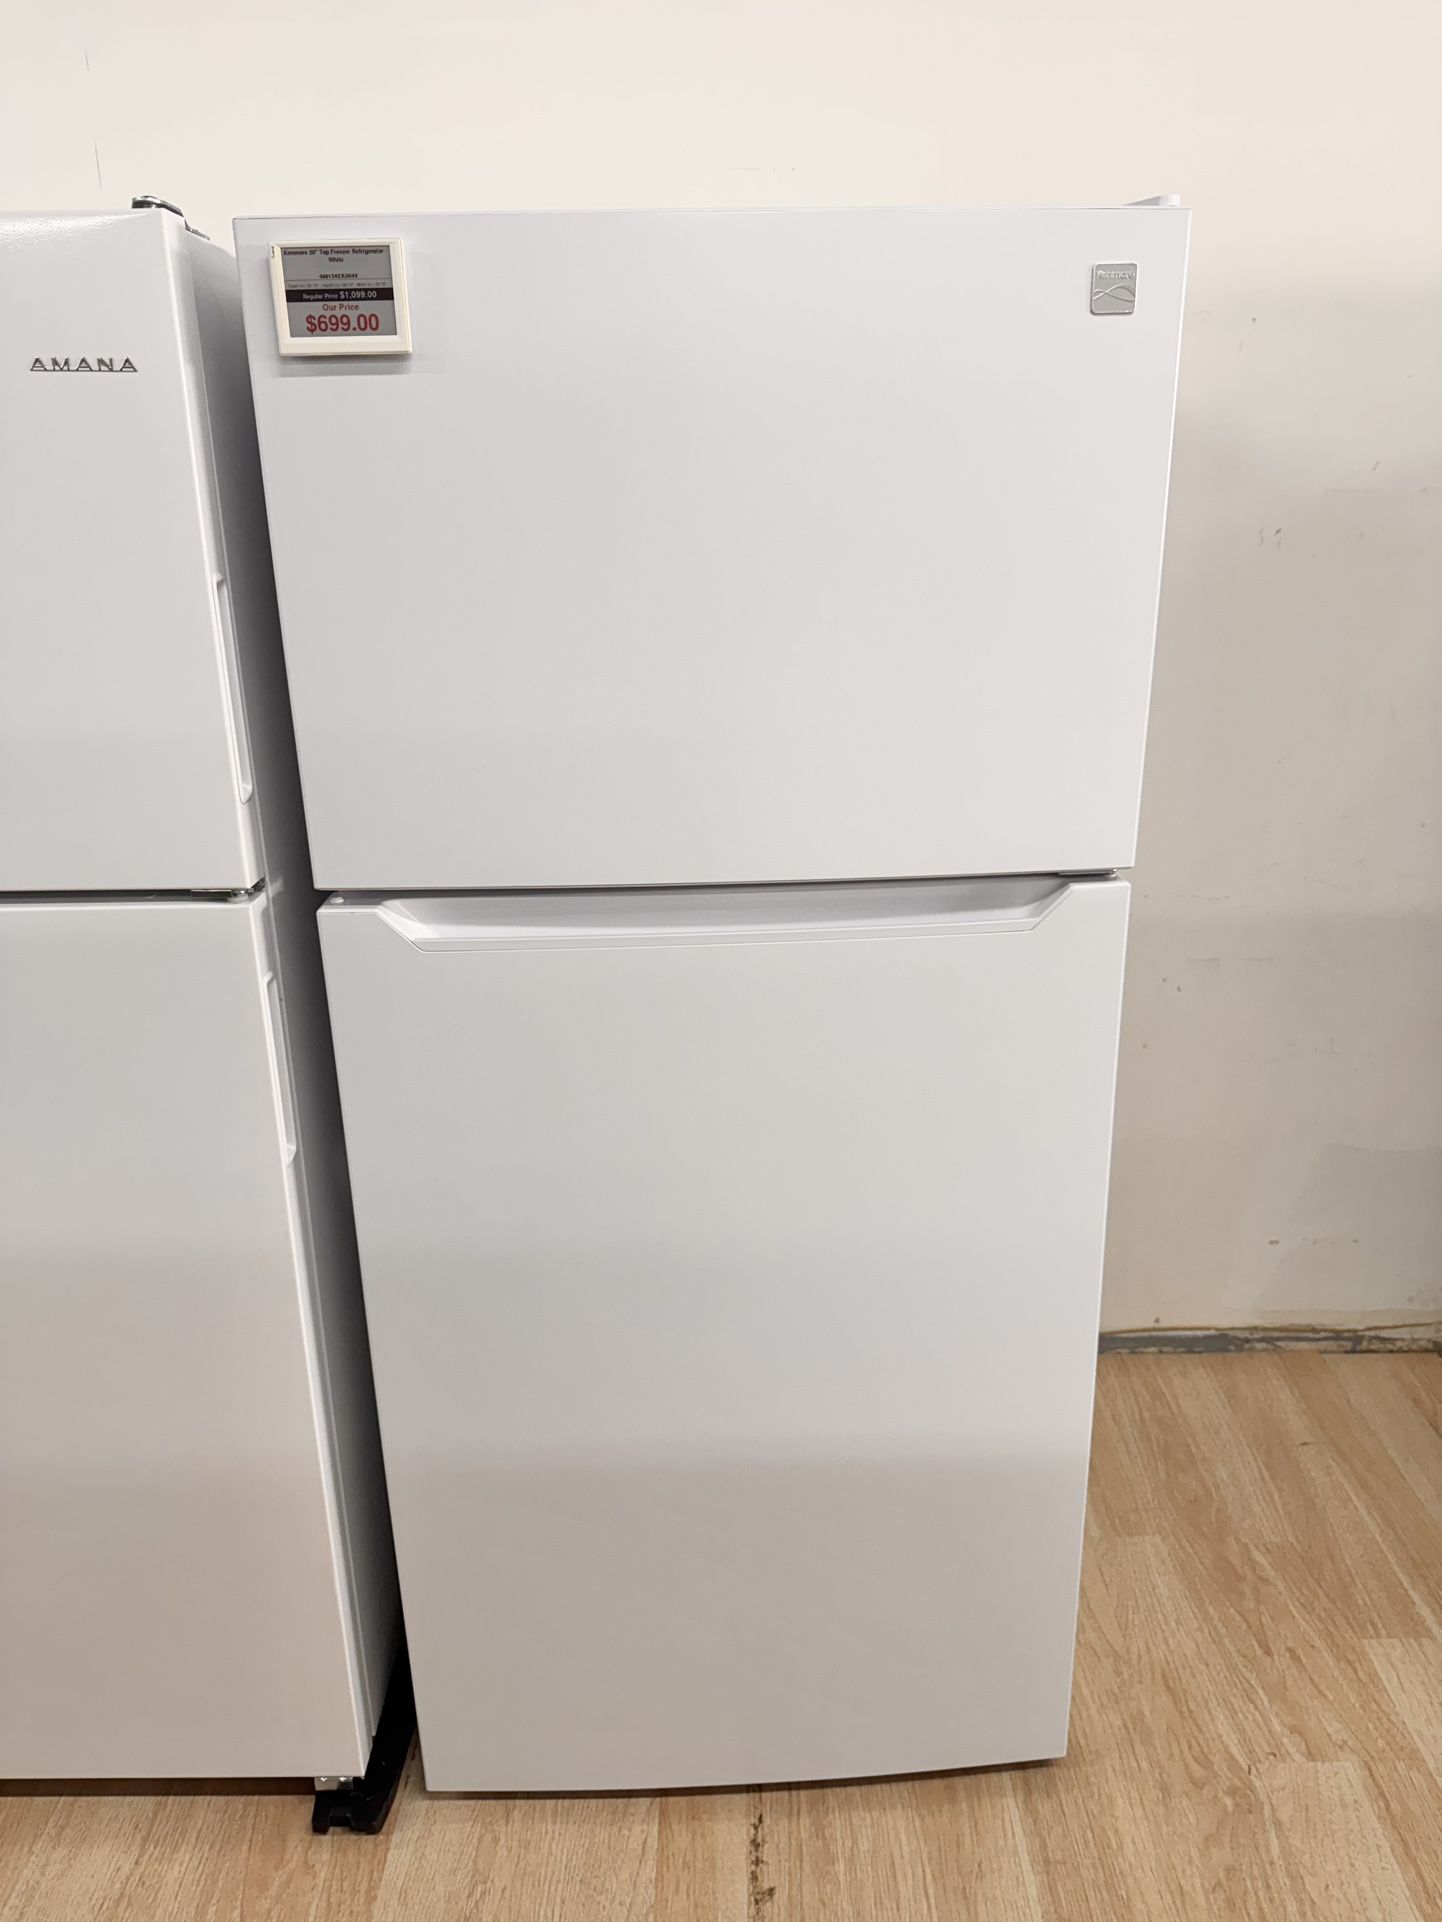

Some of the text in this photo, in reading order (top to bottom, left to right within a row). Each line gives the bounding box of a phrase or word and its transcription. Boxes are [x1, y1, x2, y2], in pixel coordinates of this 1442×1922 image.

[352, 248, 384, 256] Refrigerator
[302, 293, 323, 301] Regular
[340, 290, 377, 300] $1,099.00
[322, 303, 360, 312] Our Price
[306, 313, 380, 334] $699.00
[30, 357, 138, 372] AMANA
